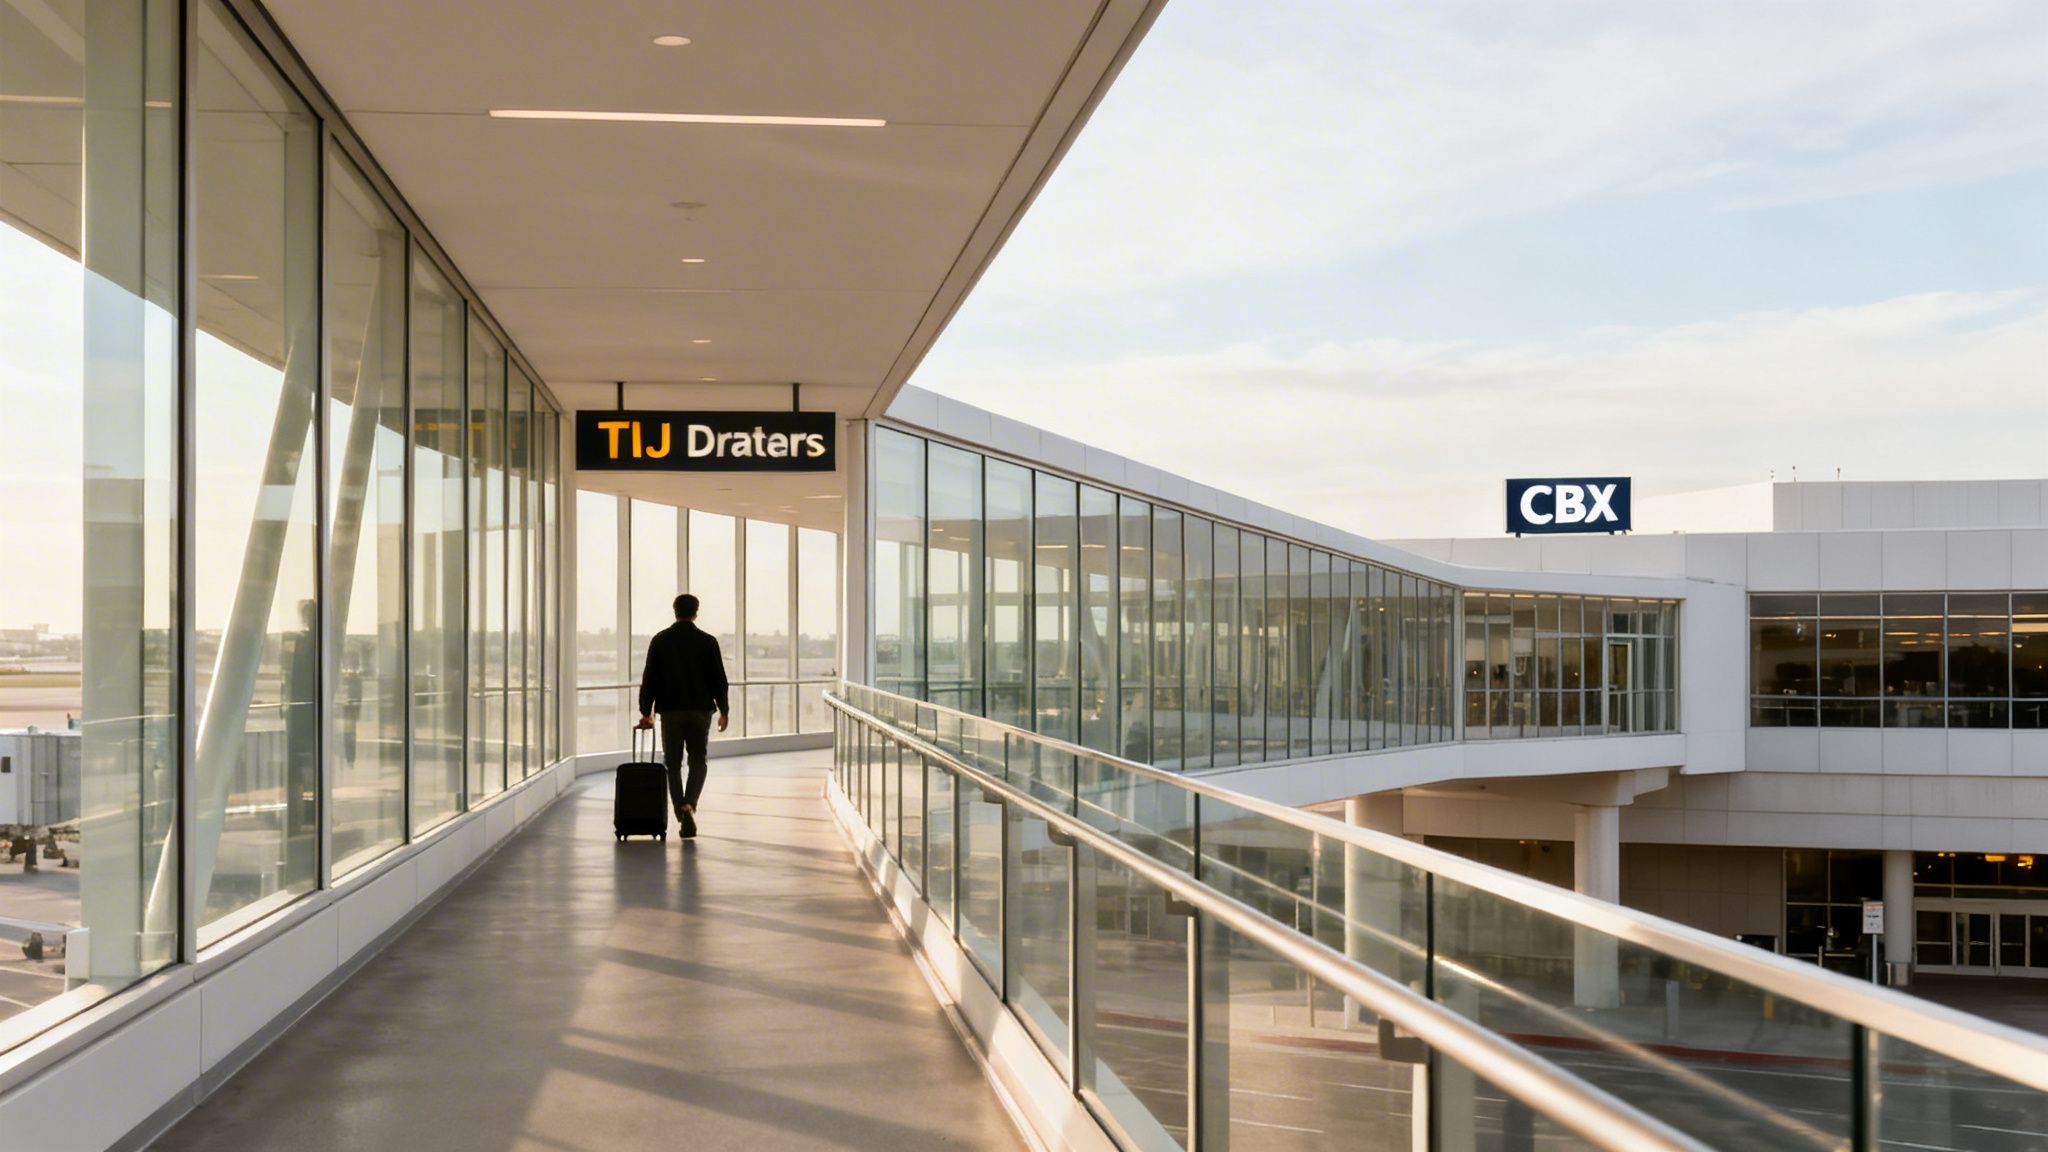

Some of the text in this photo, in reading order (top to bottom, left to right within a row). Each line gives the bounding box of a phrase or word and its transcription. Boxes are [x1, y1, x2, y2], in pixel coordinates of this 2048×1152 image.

[597, 421, 827, 459] TIJ Draters
[1520, 484, 1619, 525] CBX
